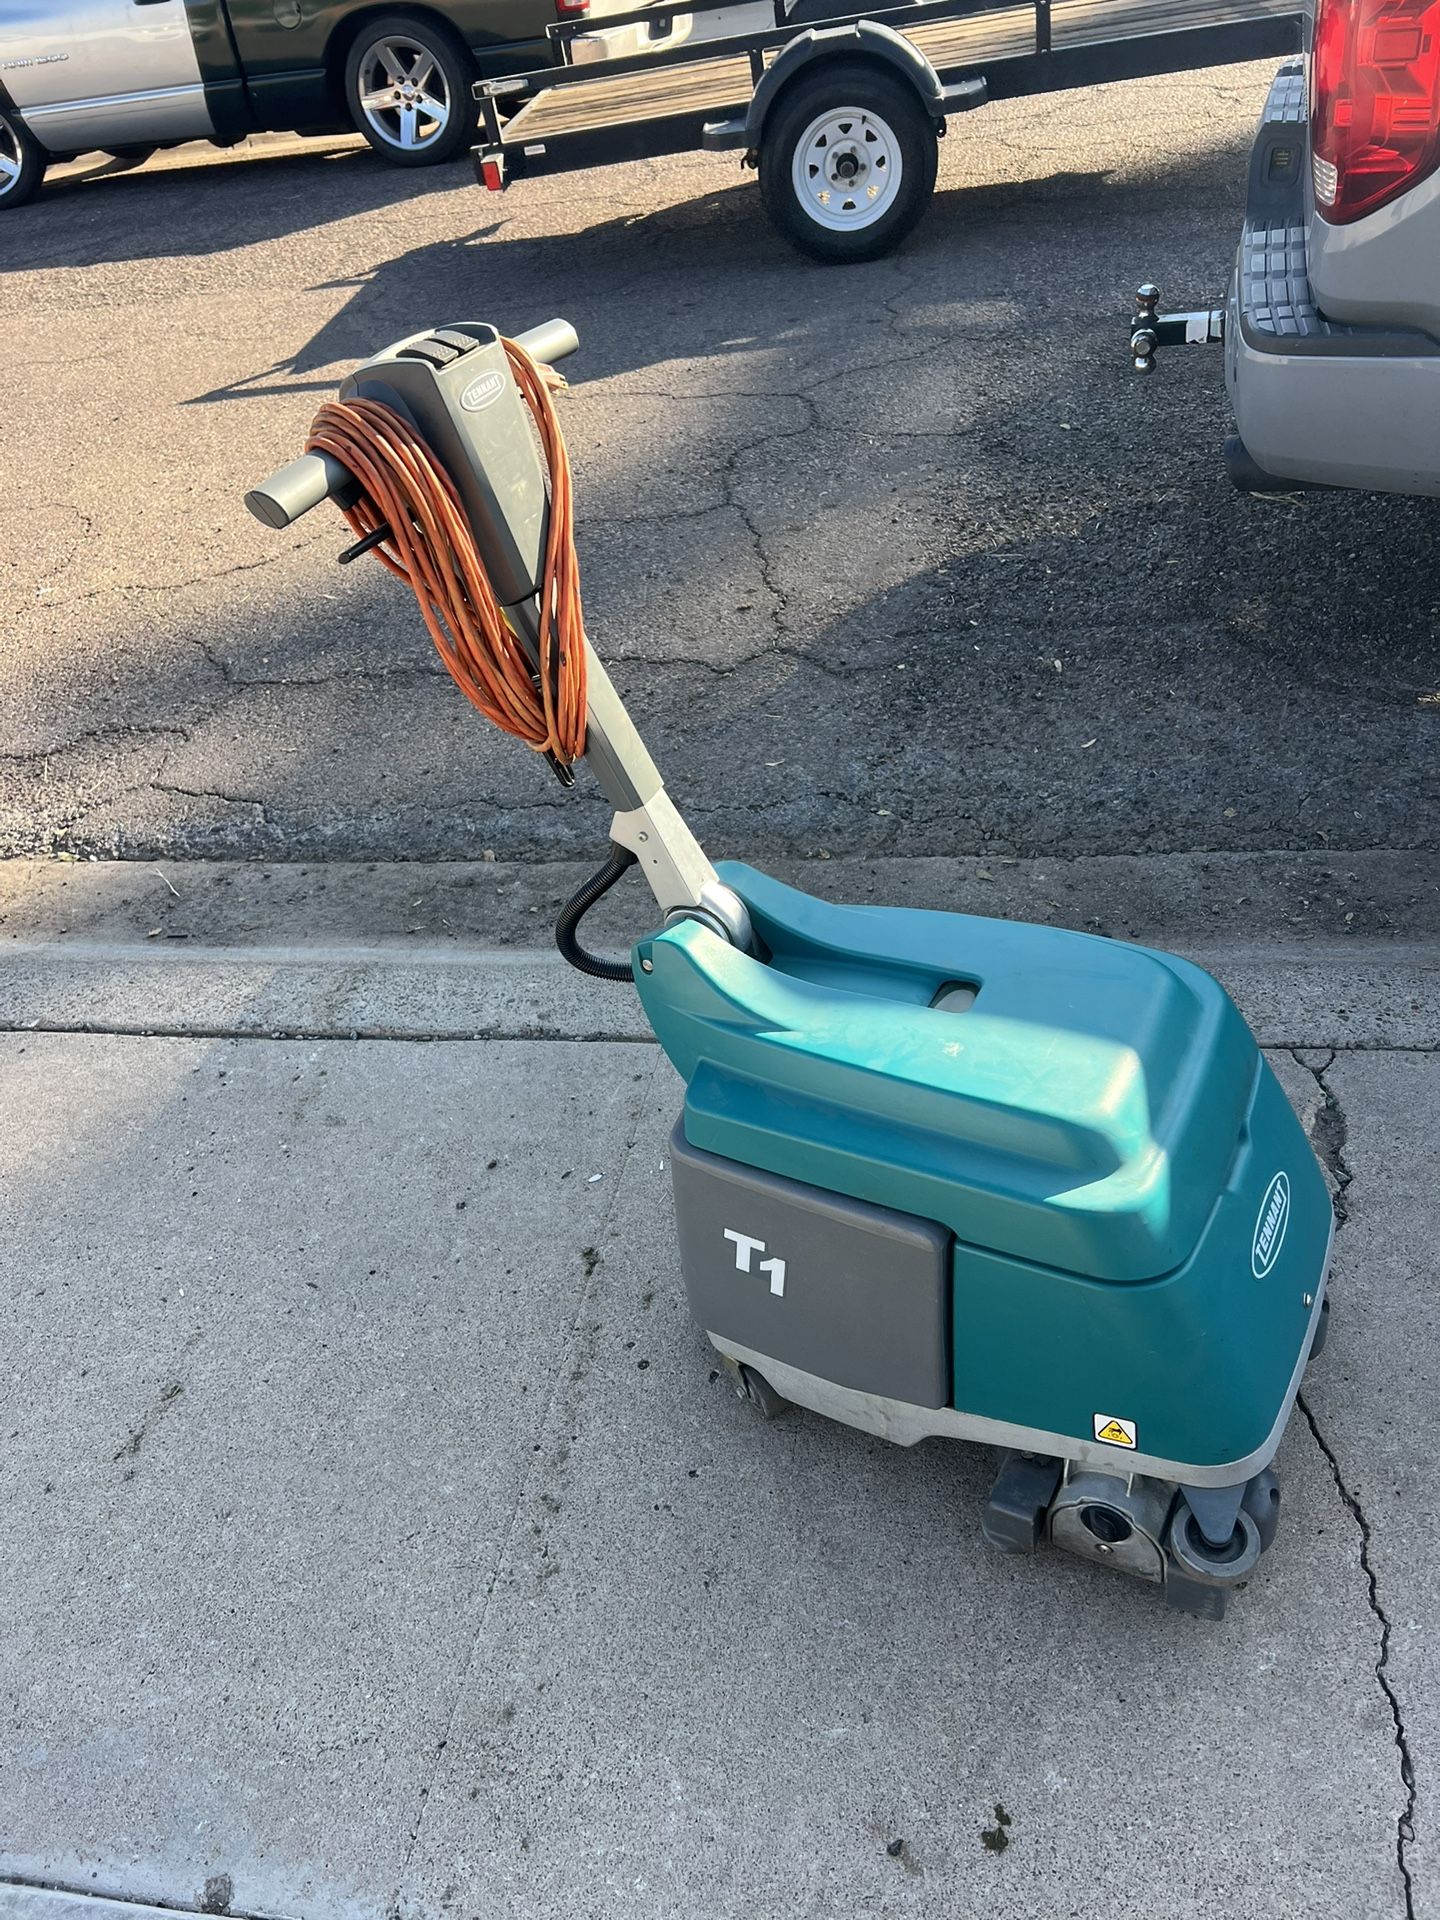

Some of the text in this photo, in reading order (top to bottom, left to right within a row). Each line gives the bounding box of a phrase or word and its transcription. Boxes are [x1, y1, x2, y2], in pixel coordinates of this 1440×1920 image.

[466, 374, 502, 406] TENNANT
[1255, 1179, 1287, 1267] TENNANT
[723, 1227, 786, 1297] T1
